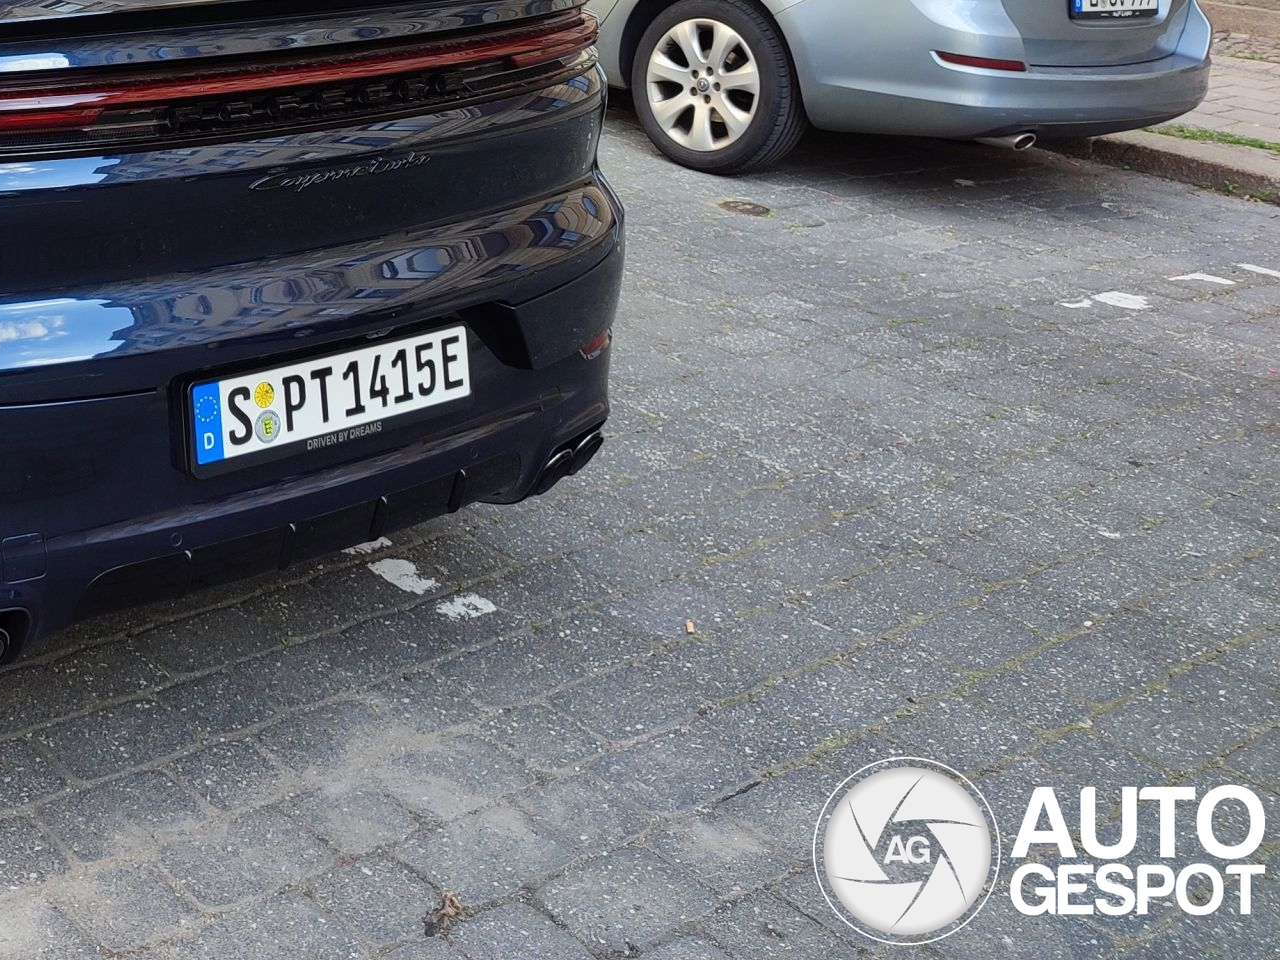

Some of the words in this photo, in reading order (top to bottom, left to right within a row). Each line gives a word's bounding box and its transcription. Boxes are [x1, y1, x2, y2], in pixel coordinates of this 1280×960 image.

[203, 431, 215, 450] D
[227, 385, 253, 446] S
[307, 433, 337, 450] DRIVEN
[338, 429, 348, 442] BY
[349, 421, 383, 439] DREAMS
